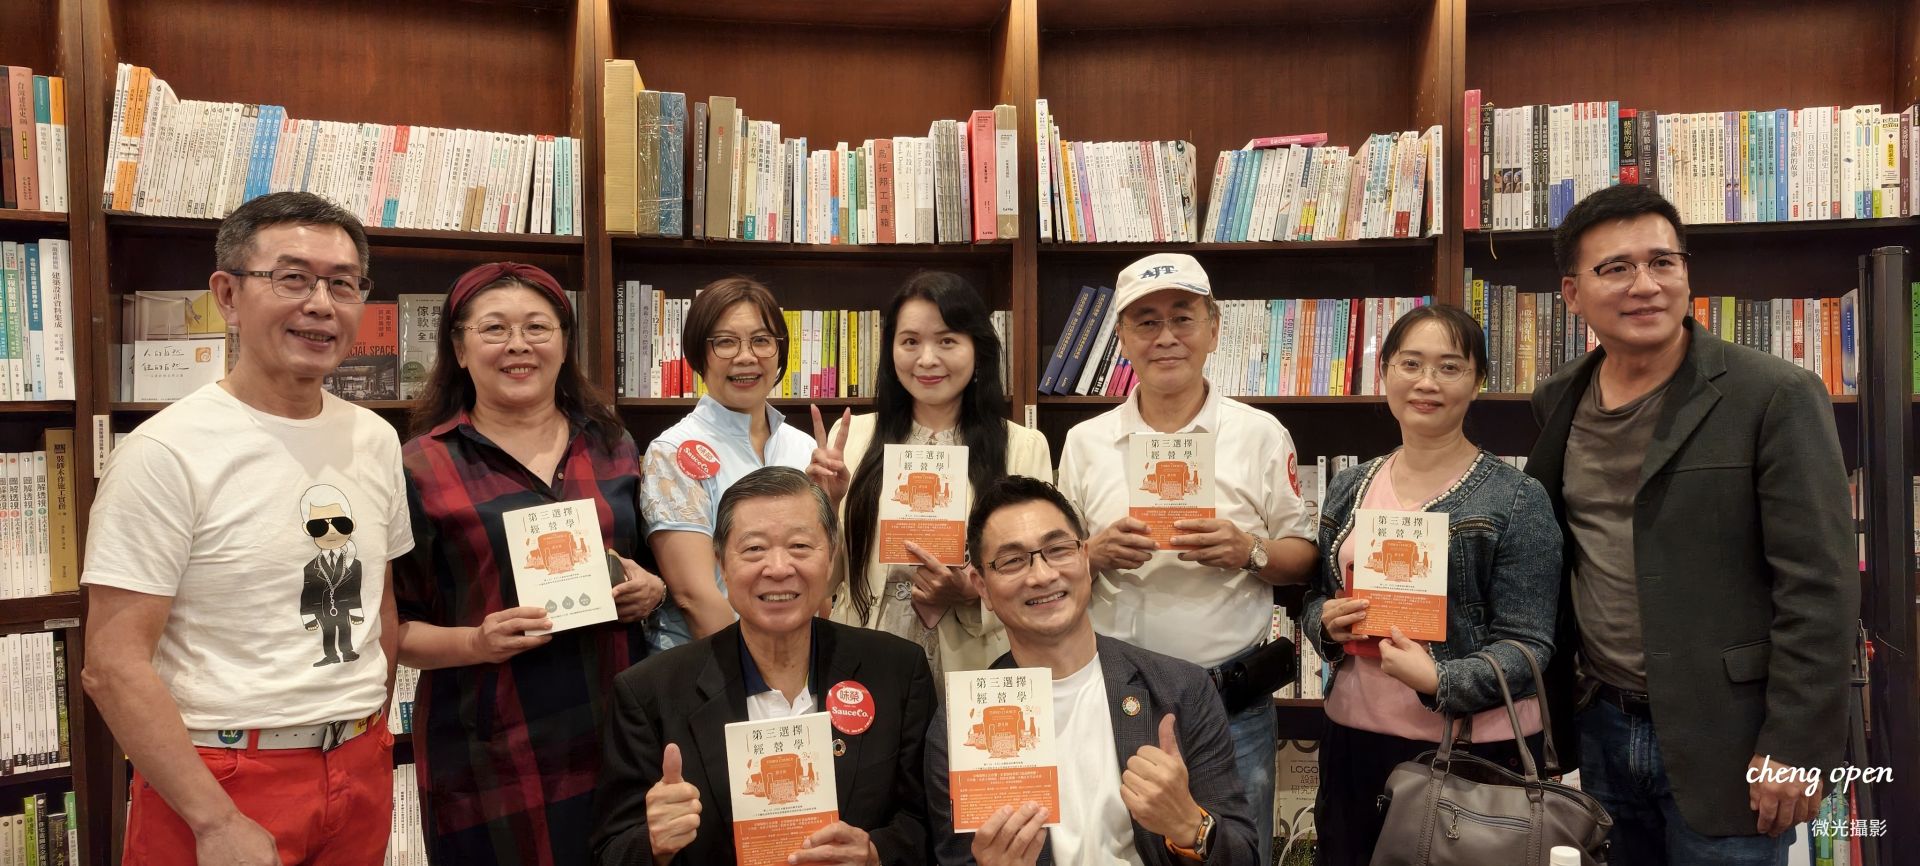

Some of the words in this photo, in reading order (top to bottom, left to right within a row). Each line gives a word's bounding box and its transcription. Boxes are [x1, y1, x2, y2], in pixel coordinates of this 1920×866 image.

[878, 149, 890, 228] 烏托邦工具箱
[1140, 265, 1174, 279] AJT
[52, 272, 62, 328] 建築設計資料集成
[370, 345, 396, 355] SPACE
[1152, 439, 1192, 448] 第三選擇
[905, 450, 944, 460] 第三選擇
[1152, 451, 1192, 459] 經營學
[904, 462, 944, 471] 經營學
[9, 478, 18, 509] 圖解透視
[24, 476, 33, 509] 圖解透視
[36, 476, 46, 508] 圖解透視
[528, 507, 572, 522] 第三選擇
[1378, 516, 1423, 526] 第三選擇
[530, 519, 574, 534] 經營學
[1378, 528, 1422, 539] 經營學
[976, 676, 1026, 688] 第三選擇
[840, 690, 860, 702] 味榮
[976, 691, 1026, 704] 經營學
[752, 724, 803, 740] 第三選擇
[754, 739, 804, 755] 經營學
[1300, 775, 1318, 784] 設計
